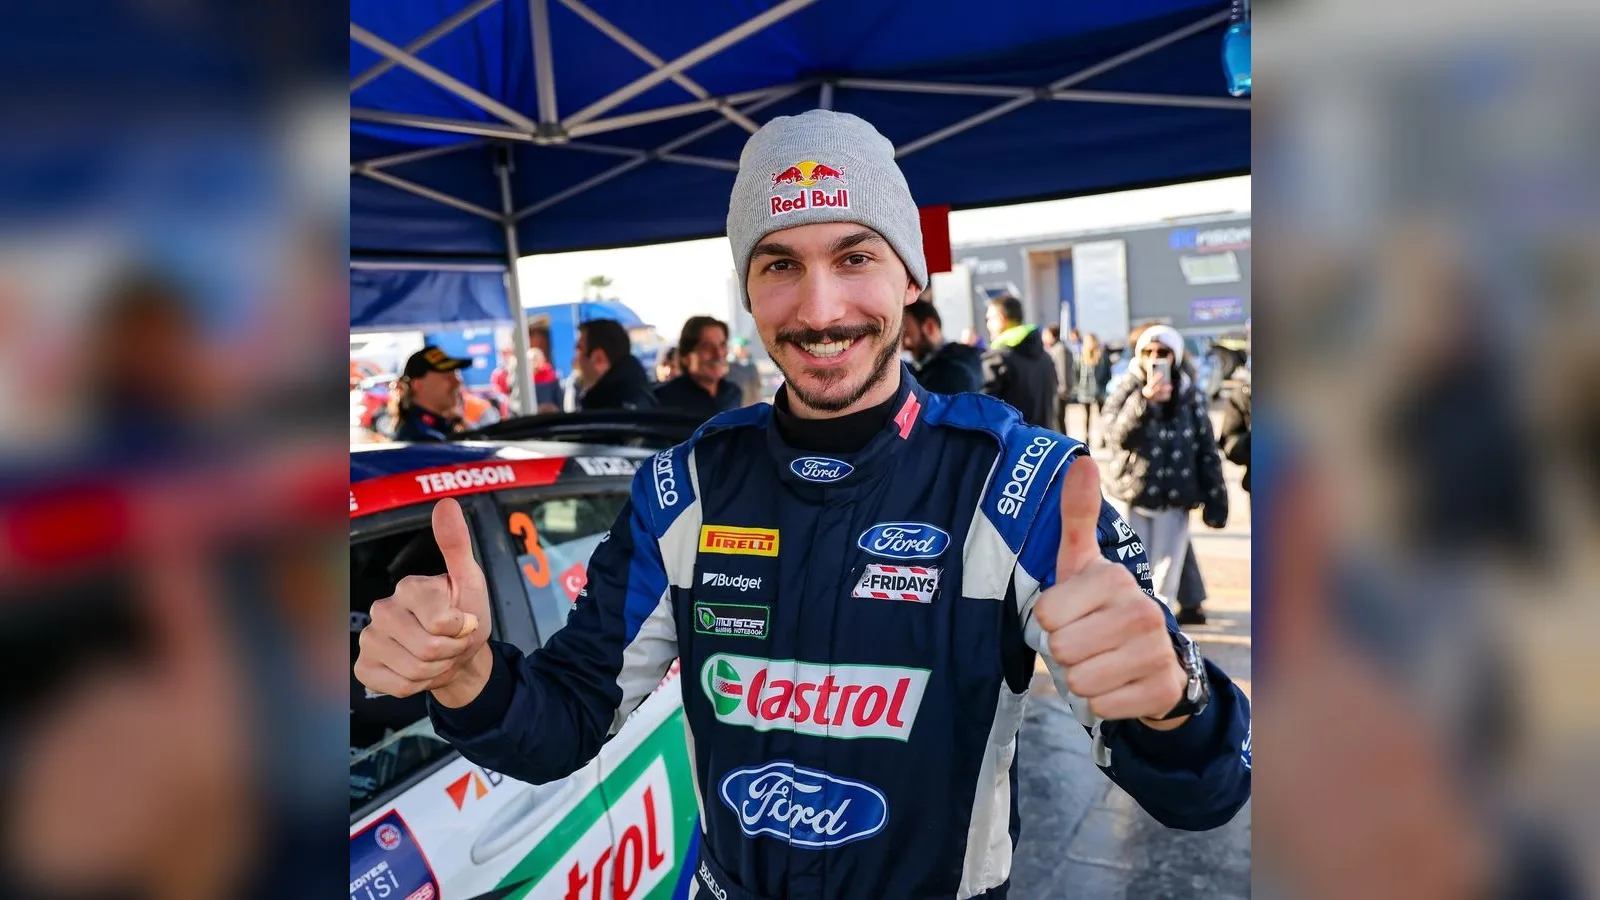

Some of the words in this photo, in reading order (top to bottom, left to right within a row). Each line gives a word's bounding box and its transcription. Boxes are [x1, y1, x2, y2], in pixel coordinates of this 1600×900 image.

[770, 191, 806, 215] Red
[811, 189, 849, 208] Bull
[416, 465, 516, 494] TEROSON
[802, 460, 841, 479] Ford
[997, 436, 1058, 519] sparco
[509, 512, 550, 588] 3
[706, 531, 775, 551] PIRELLI
[874, 527, 936, 553] Ford
[717, 573, 762, 592] Budget
[870, 574, 935, 593] FRIDAYS
[746, 667, 911, 728] Castrol
[742, 772, 852, 836] Ford
